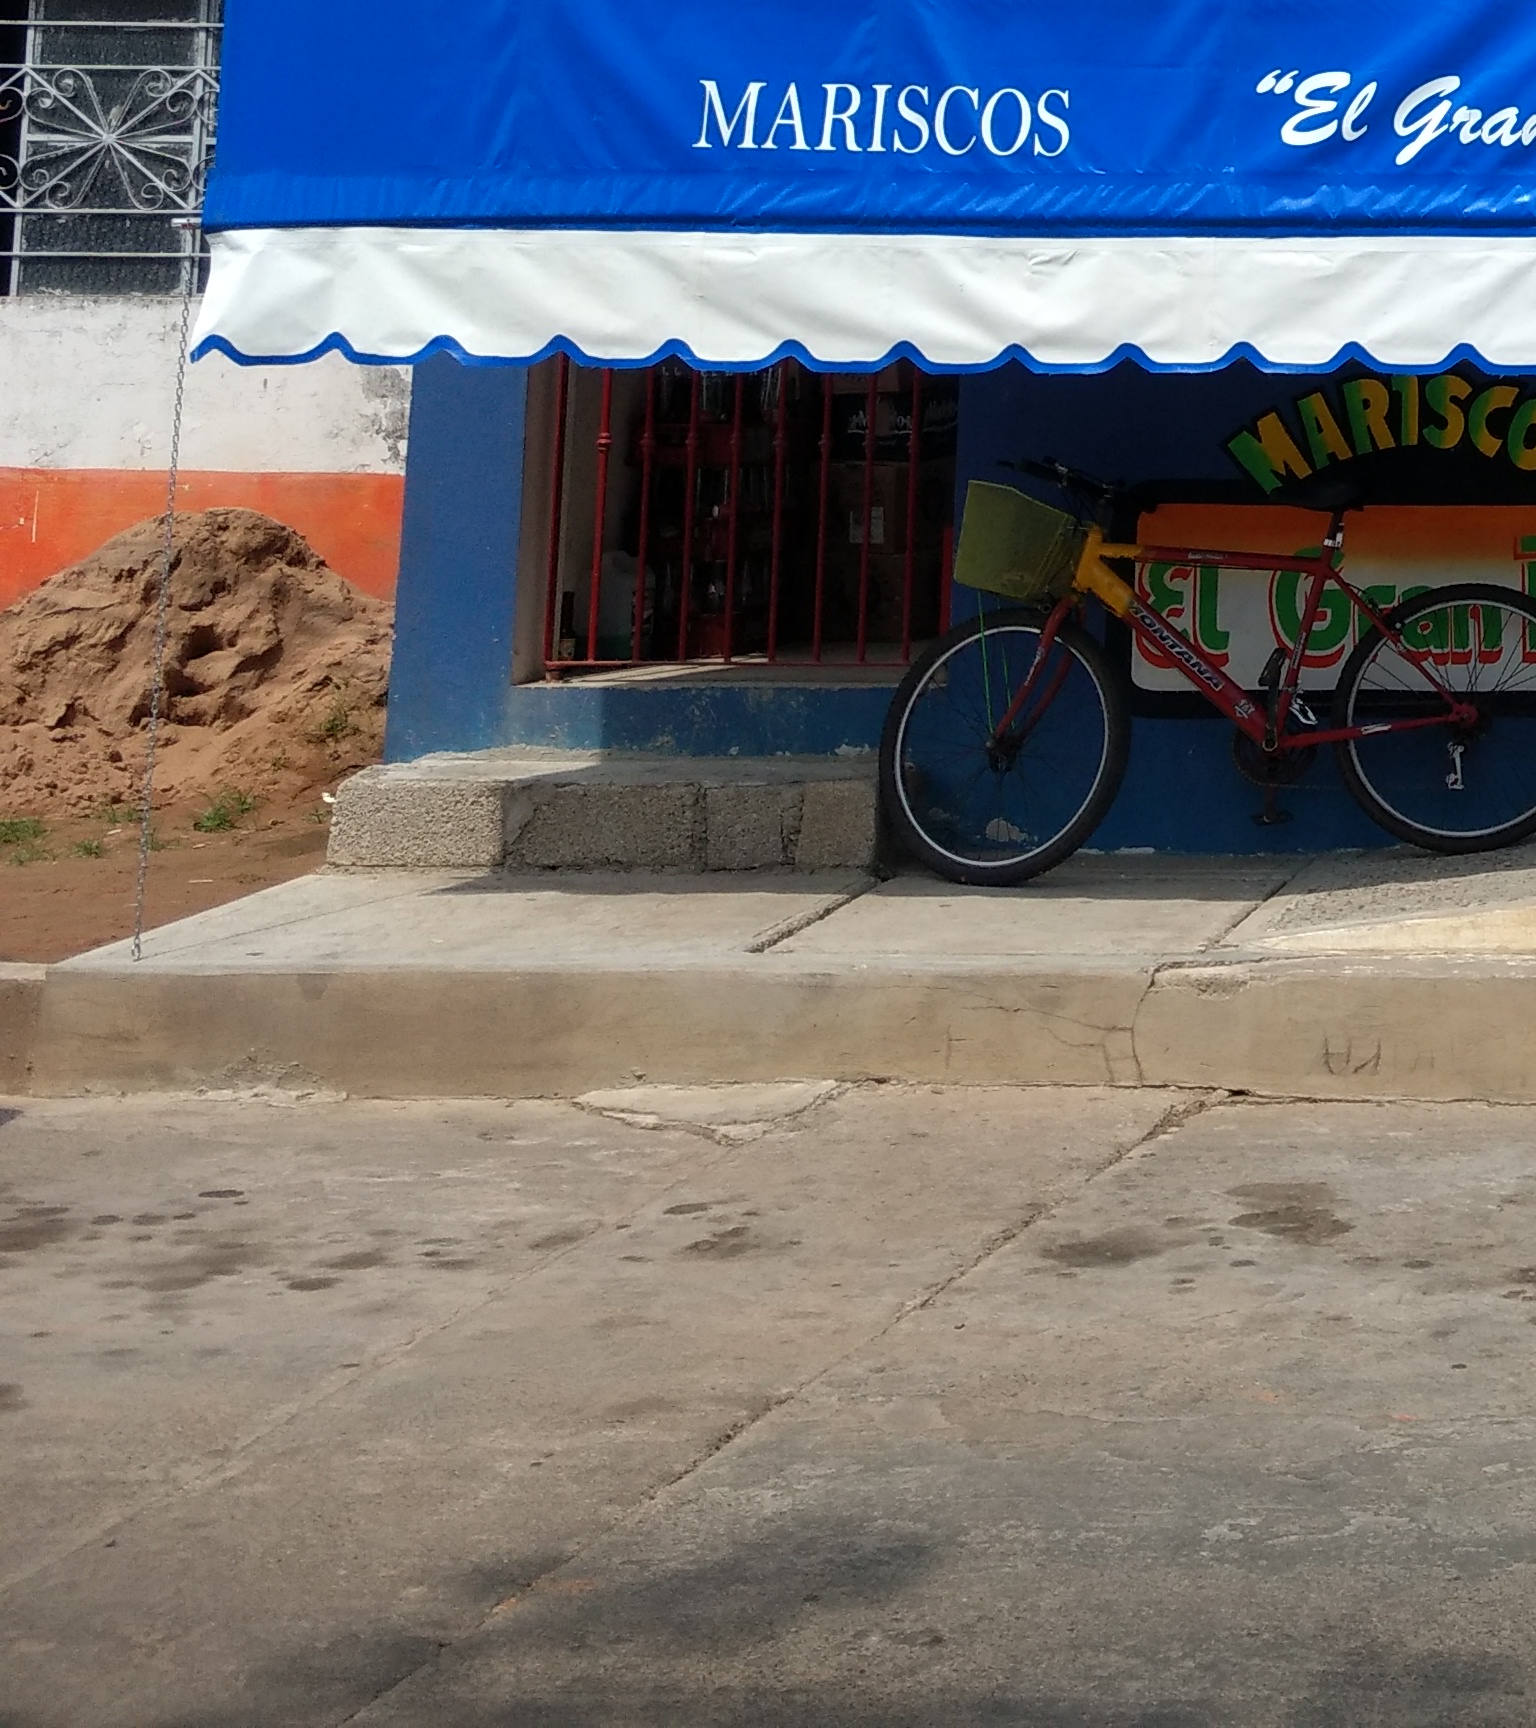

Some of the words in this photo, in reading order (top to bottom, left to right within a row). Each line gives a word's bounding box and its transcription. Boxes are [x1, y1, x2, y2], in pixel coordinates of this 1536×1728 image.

[691, 79, 1070, 157] MARISCOS
[1256, 69, 1377, 146] “El
[1132, 559, 1230, 670] El
